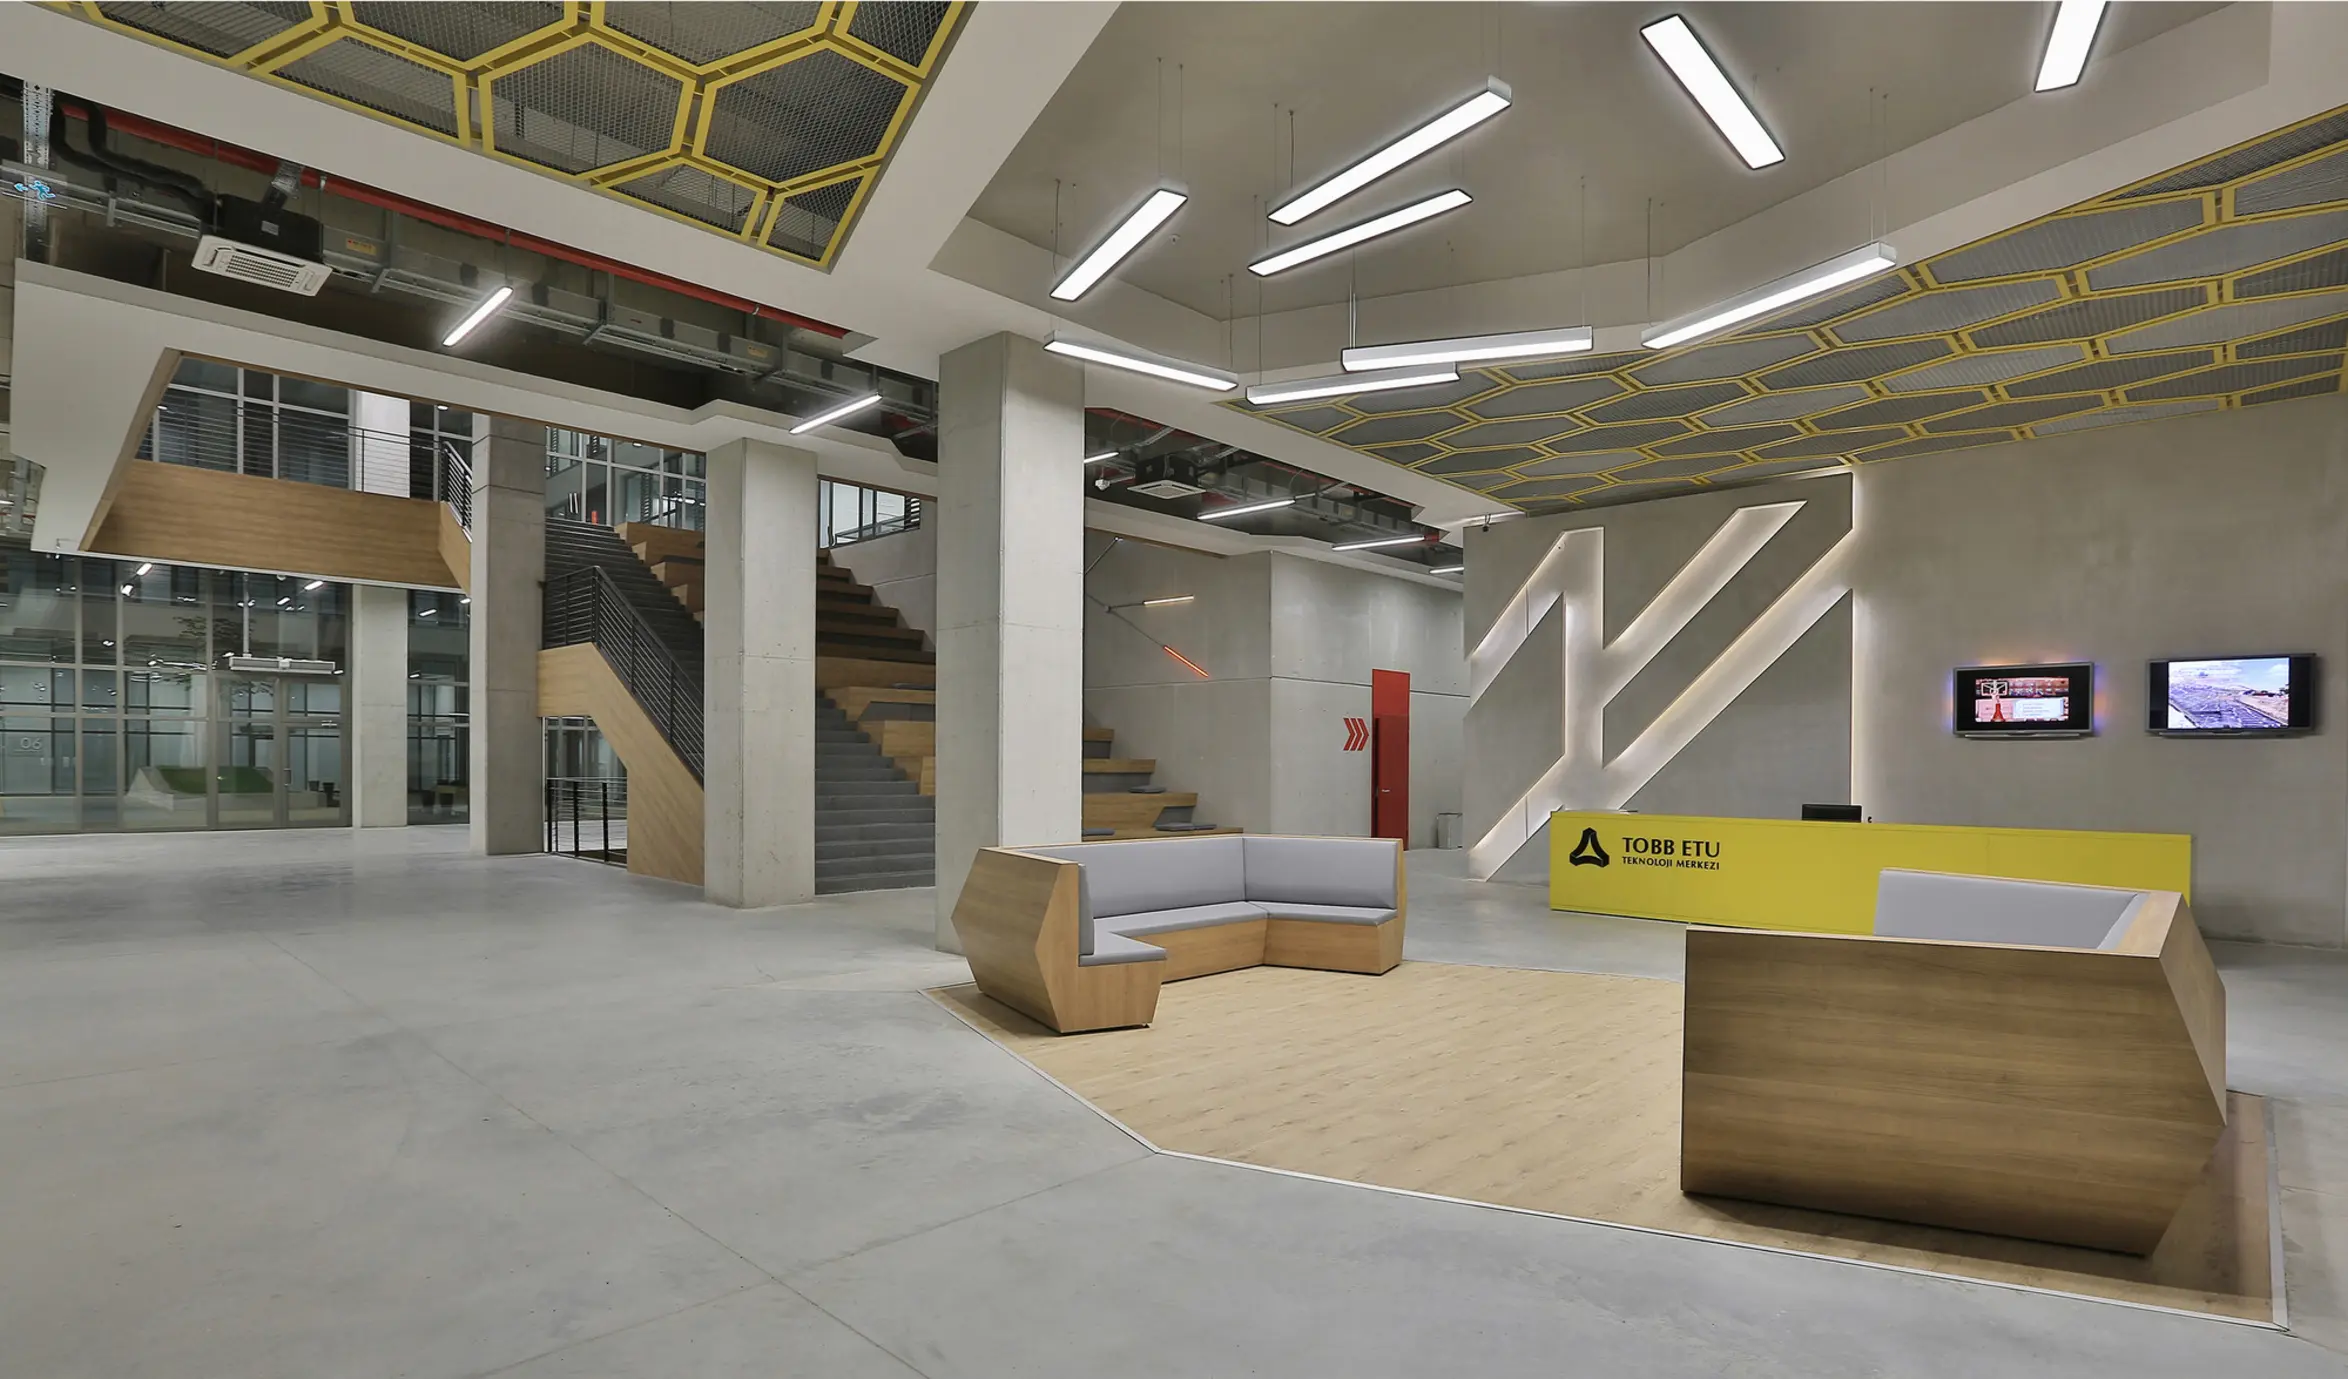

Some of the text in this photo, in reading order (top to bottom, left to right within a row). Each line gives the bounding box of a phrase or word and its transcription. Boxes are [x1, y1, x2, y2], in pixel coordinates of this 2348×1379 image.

[1622, 837, 1720, 858] TOBB ETU
[1622, 856, 1720, 870] TEKNOLOJI MERKEZI
